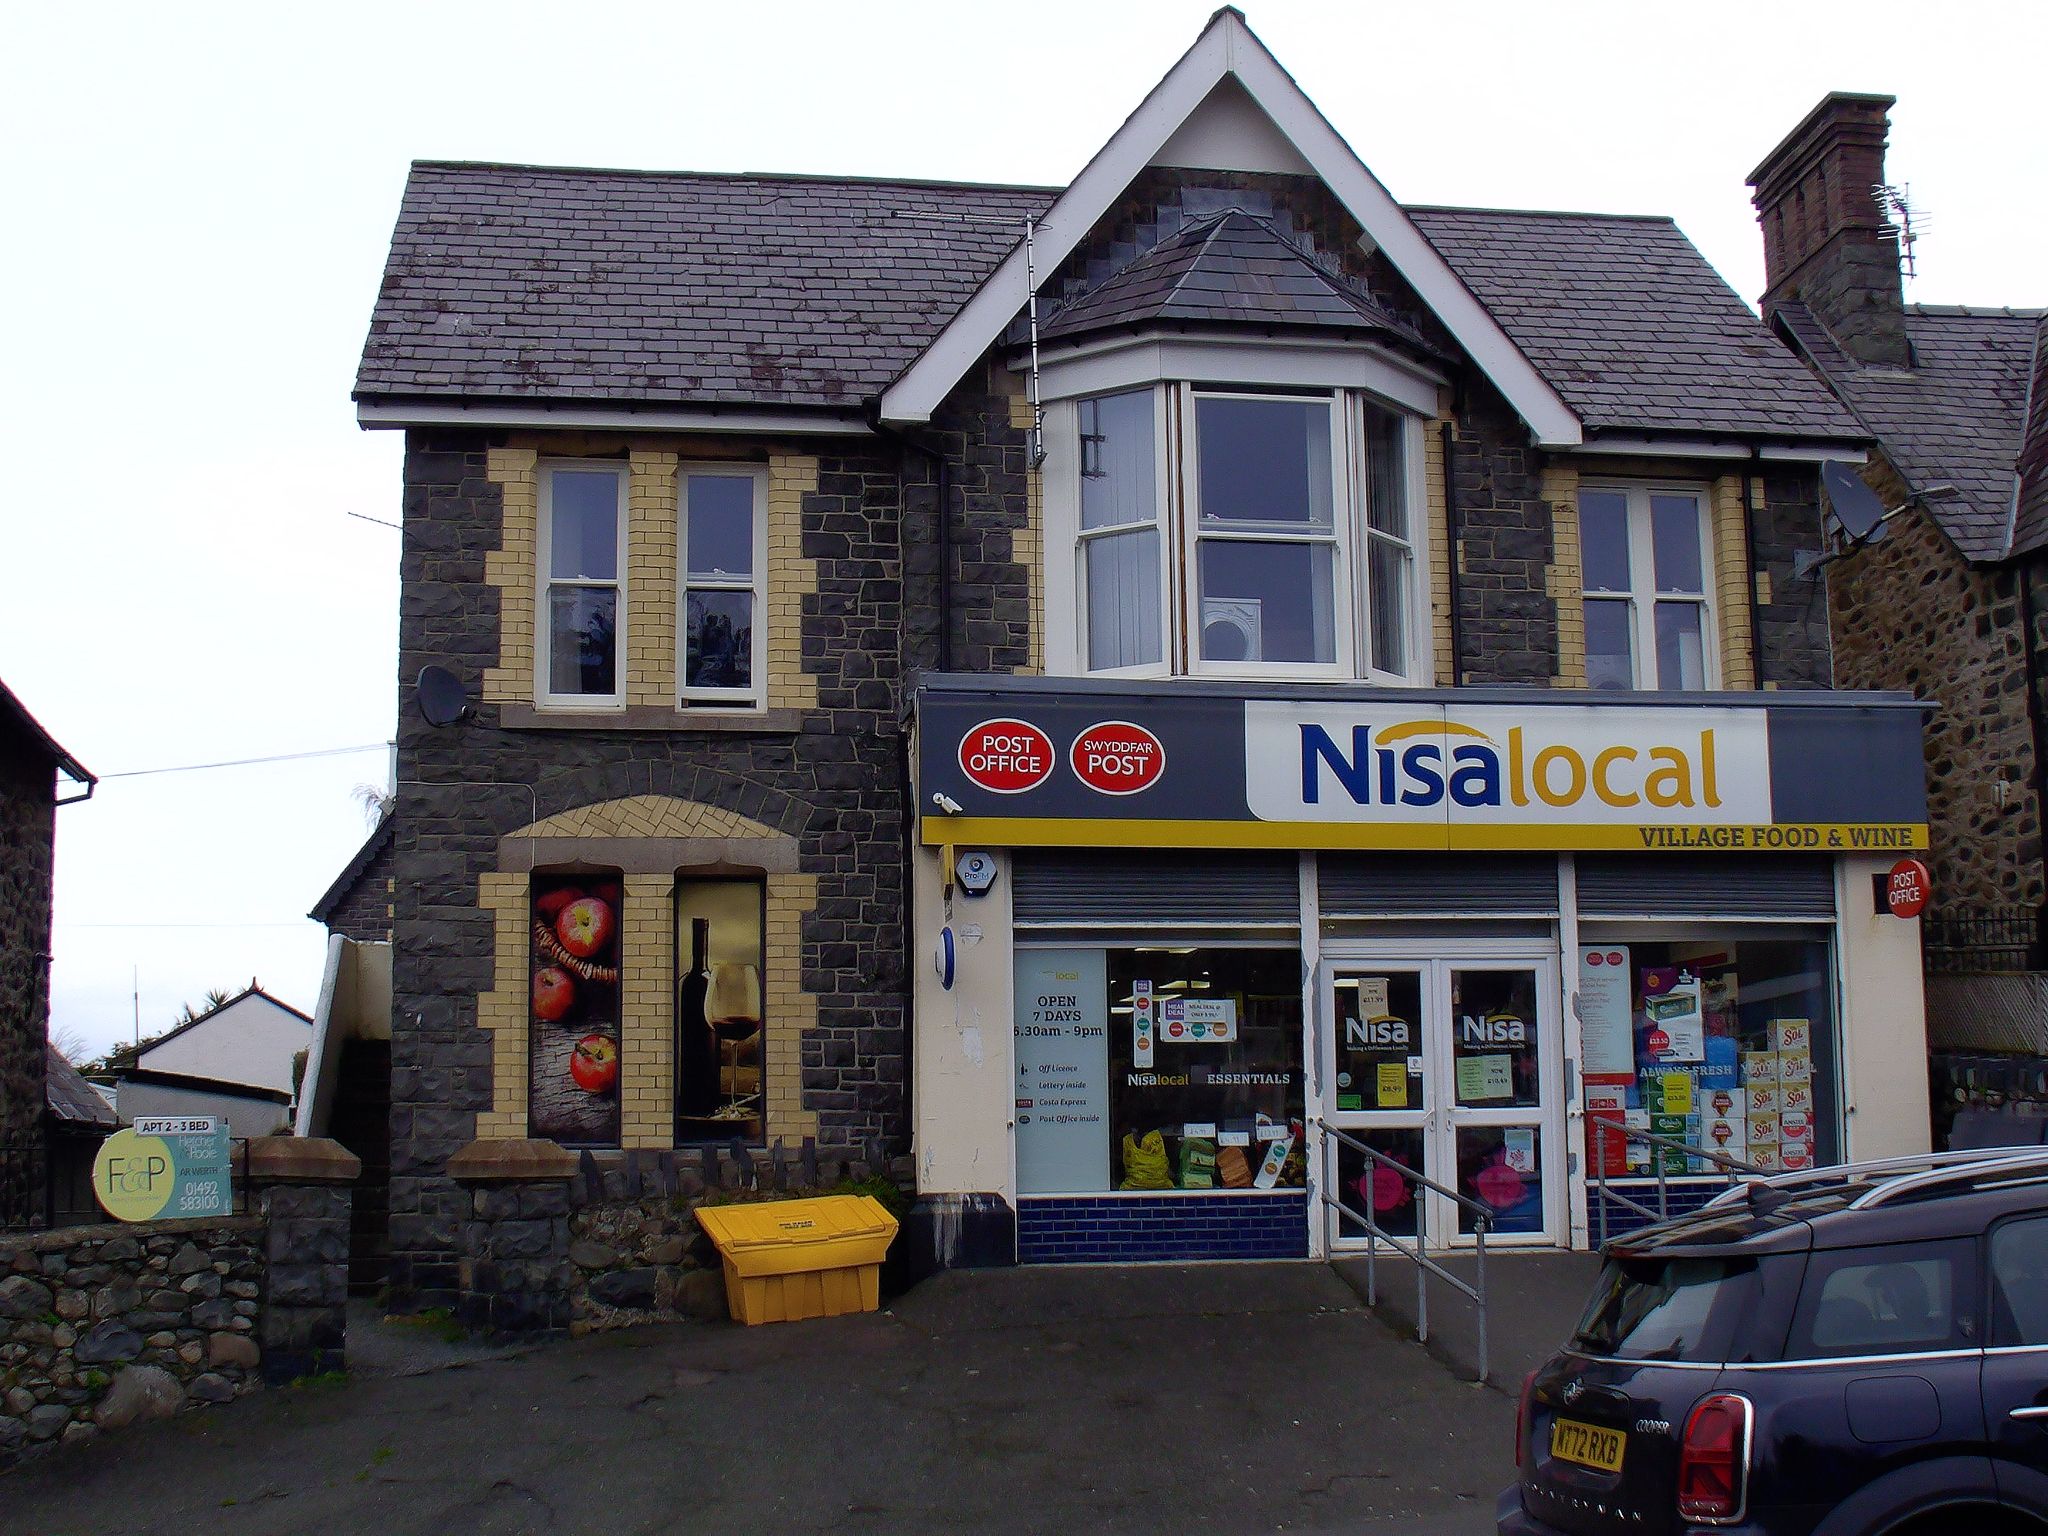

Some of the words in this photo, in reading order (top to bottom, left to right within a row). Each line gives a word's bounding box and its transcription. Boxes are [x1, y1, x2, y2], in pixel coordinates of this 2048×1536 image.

[982, 734, 1034, 753] POST
[969, 755, 1041, 774] OFFICE
[1088, 755, 1149, 776] POST
[1639, 827, 1745, 848] VILLAGE
[1752, 827, 1819, 847] FOOD
[1826, 828, 1844, 847] &
[1849, 827, 1913, 847] WINE
[1893, 870, 1917, 889] POST
[1889, 886, 1921, 905] OFFICE
[1037, 995, 1077, 1007] OPEN
[1033, 1011, 1040, 1021] 7
[1045, 1010, 1082, 1021] DAYS
[1013, 1025, 1061, 1037] 6.30am
[1073, 1025, 1103, 1038] 9pm
[1346, 1016, 1410, 1044] Nisa
[1462, 1015, 1526, 1042] Nisa
[1038, 1064, 1050, 1074] Off
[1052, 1064, 1078, 1073] Licence
[1693, 1065, 1733, 1076] FRESH
[1038, 1082, 1065, 1091] Lottery
[1207, 1073, 1291, 1085] ESSENTIALS
[142, 1122, 163, 1132] APT
[165, 1122, 173, 1131] 2
[180, 1121, 187, 1131] 3
[188, 1121, 210, 1131] BED
[1056, 1114, 1078, 1124] Office
[108, 1156, 166, 1194] F&P
[185, 1181, 219, 1196] 01492
[179, 1195, 220, 1211] 583100
[1635, 1419, 1672, 1433] COOPER
[1589, 1433, 1619, 1464] RXB
